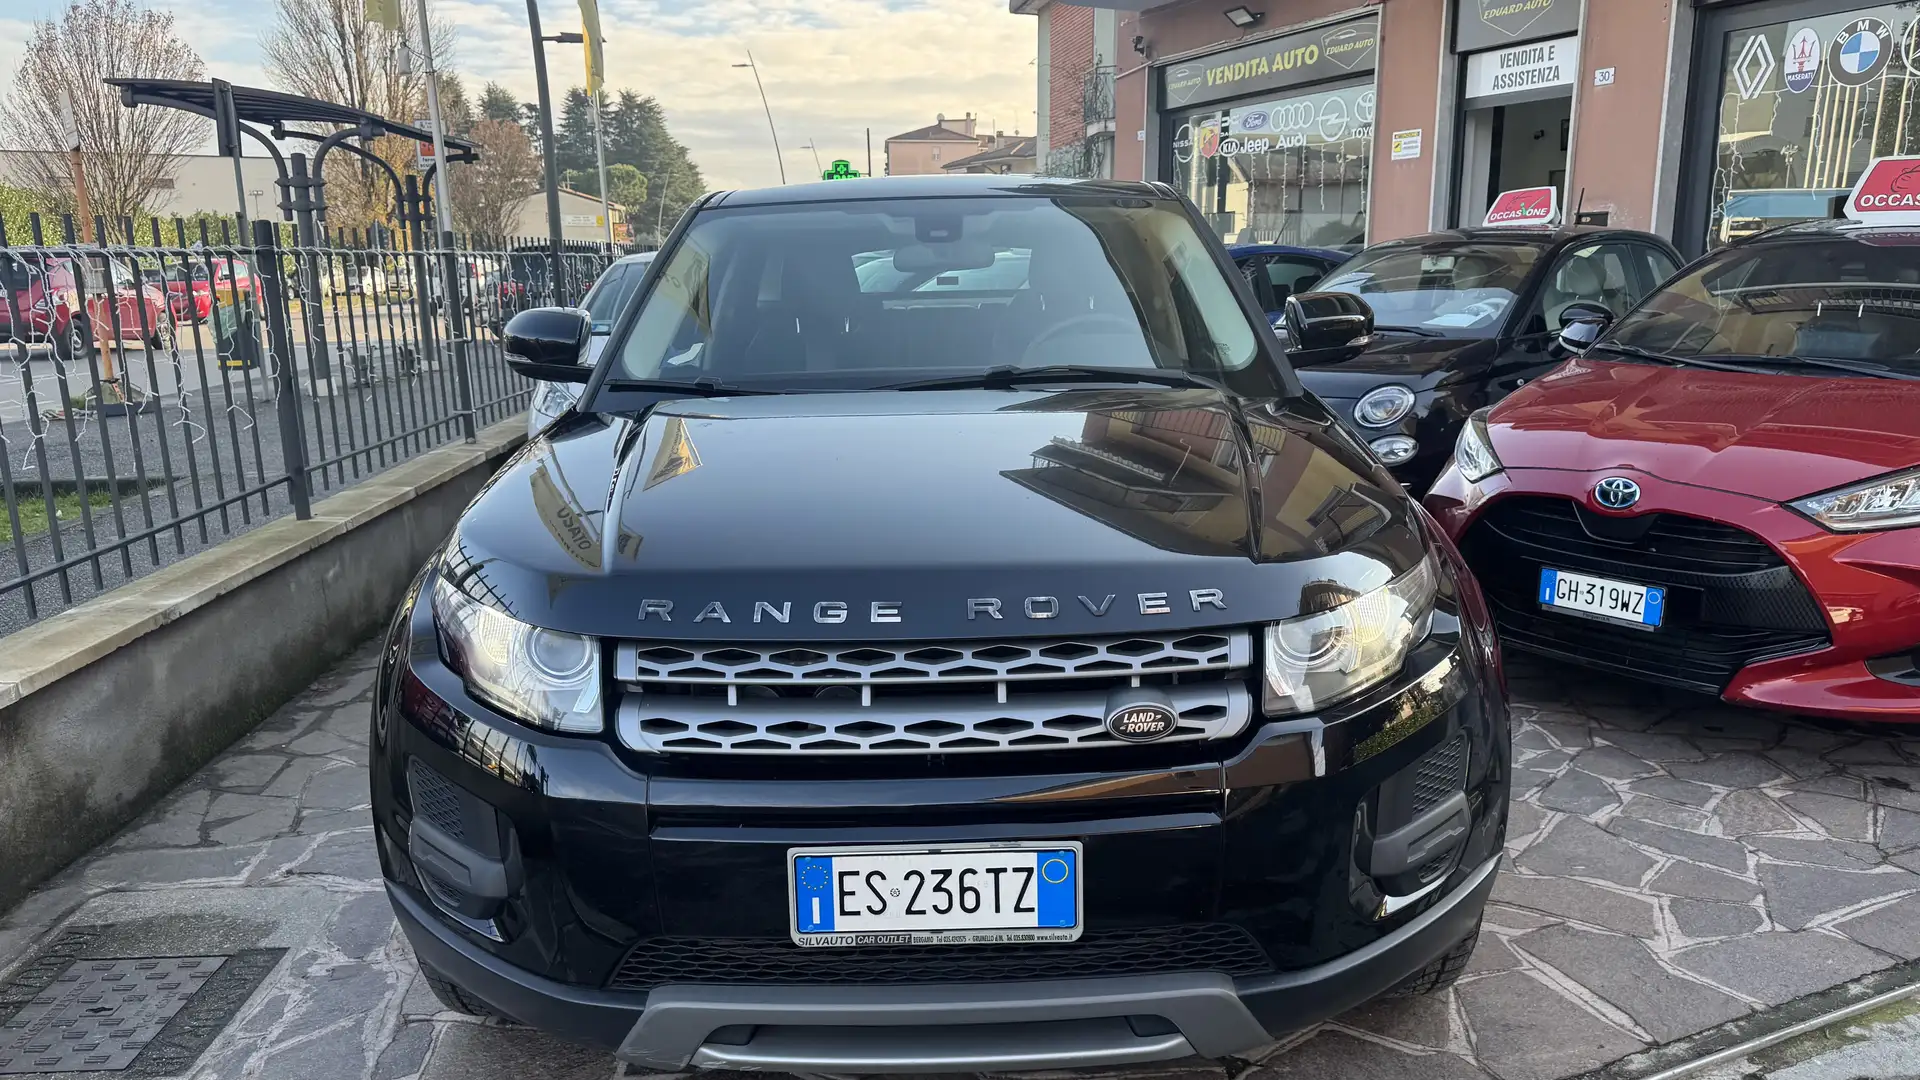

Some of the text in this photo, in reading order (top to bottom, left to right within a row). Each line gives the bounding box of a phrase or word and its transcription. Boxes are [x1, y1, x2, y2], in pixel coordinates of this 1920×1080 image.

[1483, 3, 1523, 19] EDUARD
[1837, 19, 1889, 45] BMW
[1326, 38, 1374, 55] EDUARD AUTO
[1206, 44, 1319, 87] VENDITA AUTO
[1500, 45, 1555, 69] VENDITA E
[1492, 65, 1560, 91] ASSISTENZA
[1598, 71, 1610, 82] 30
[1787, 72, 1813, 82] MASERATI
[1245, 114, 1263, 128] Ford
[1222, 142, 1237, 153] KIA
[1241, 136, 1270, 155] Jeep
[1276, 133, 1307, 150] Audi
[967, 588, 1228, 620] ROVER
[1556, 578, 1579, 604] GH
[1584, 583, 1644, 615] 319WZ
[637, 599, 902, 624] RANGE
[1123, 712, 1155, 723] LAND
[1126, 721, 1165, 733] ROVER
[838, 870, 887, 916] ES
[903, 867, 1035, 916] 236TZ
[798, 935, 854, 946] SILVAUTO
[857, 936, 875, 944] CAR
[877, 935, 909, 944] OUTLET
